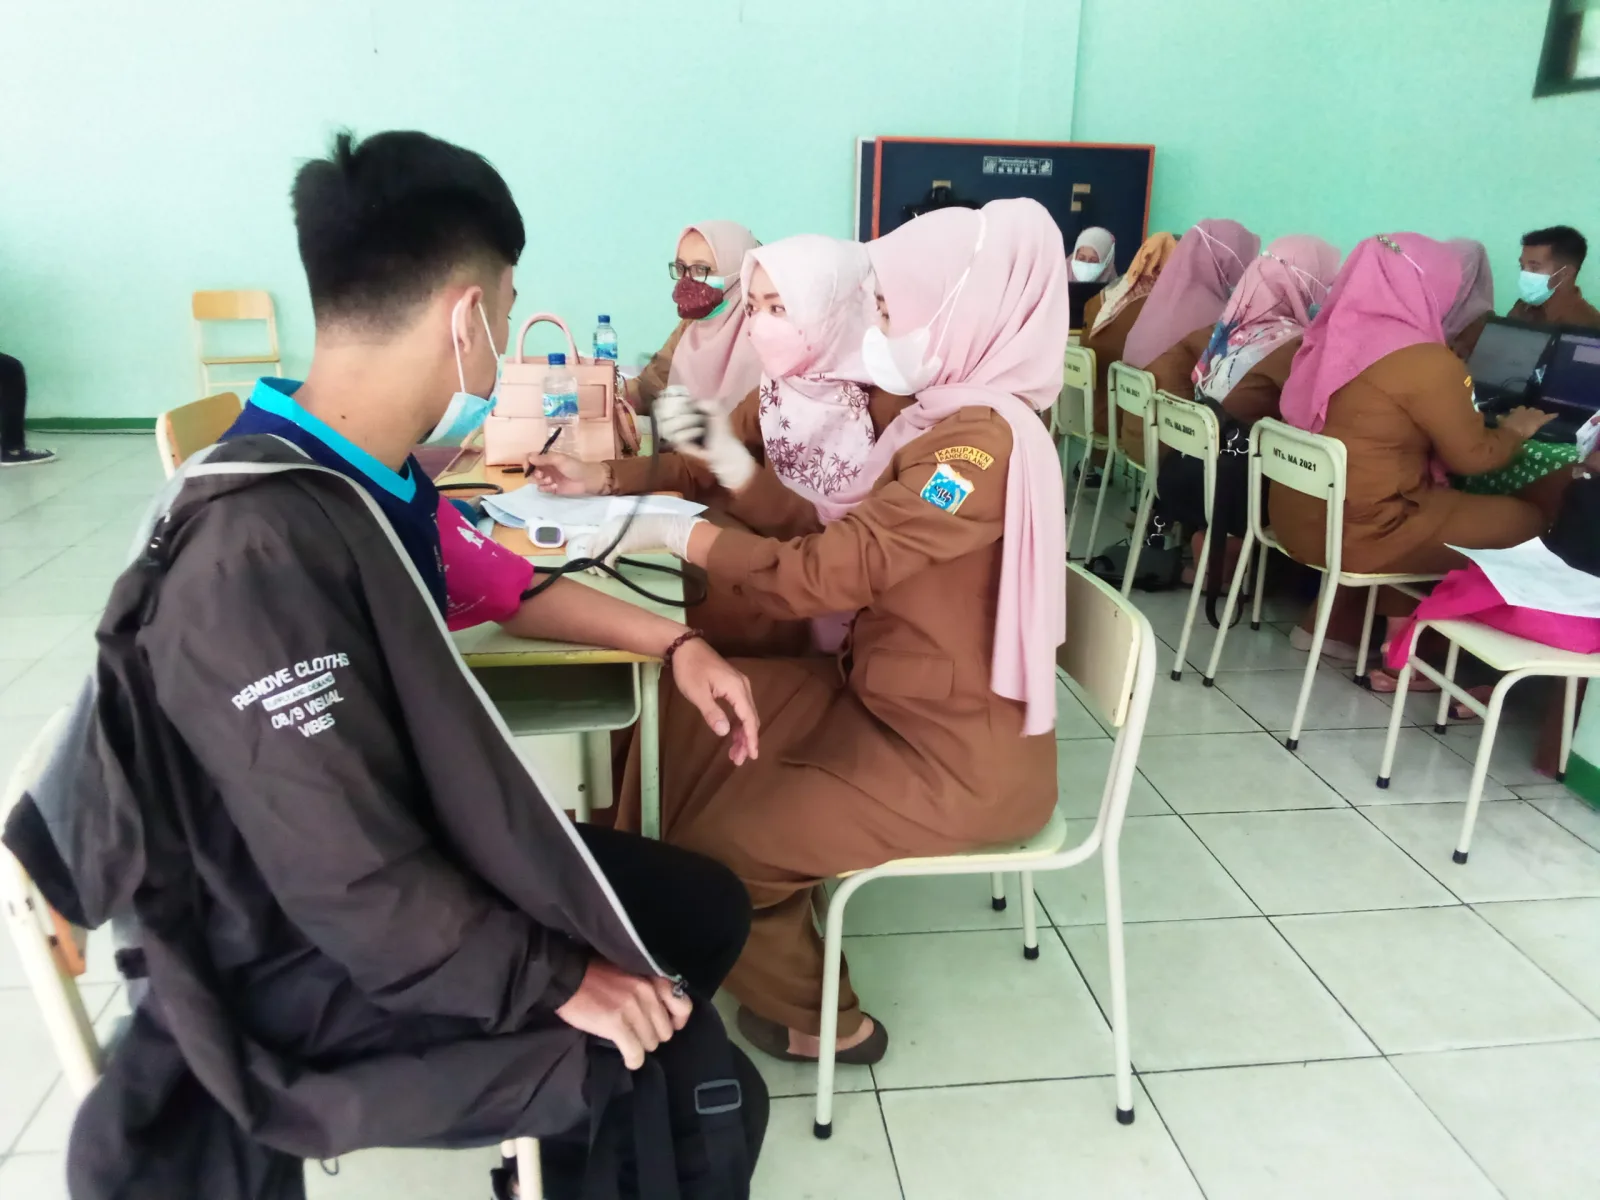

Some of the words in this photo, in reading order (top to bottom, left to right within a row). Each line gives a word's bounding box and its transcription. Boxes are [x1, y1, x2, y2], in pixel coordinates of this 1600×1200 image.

[939, 447, 991, 463] KABUPATEN
[1300, 458, 1317, 472] 2021
[231, 667, 294, 711] REMOVE
[294, 652, 350, 678] CLOTHS
[303, 689, 344, 716] VISUAL
[298, 713, 336, 738] VIBES
